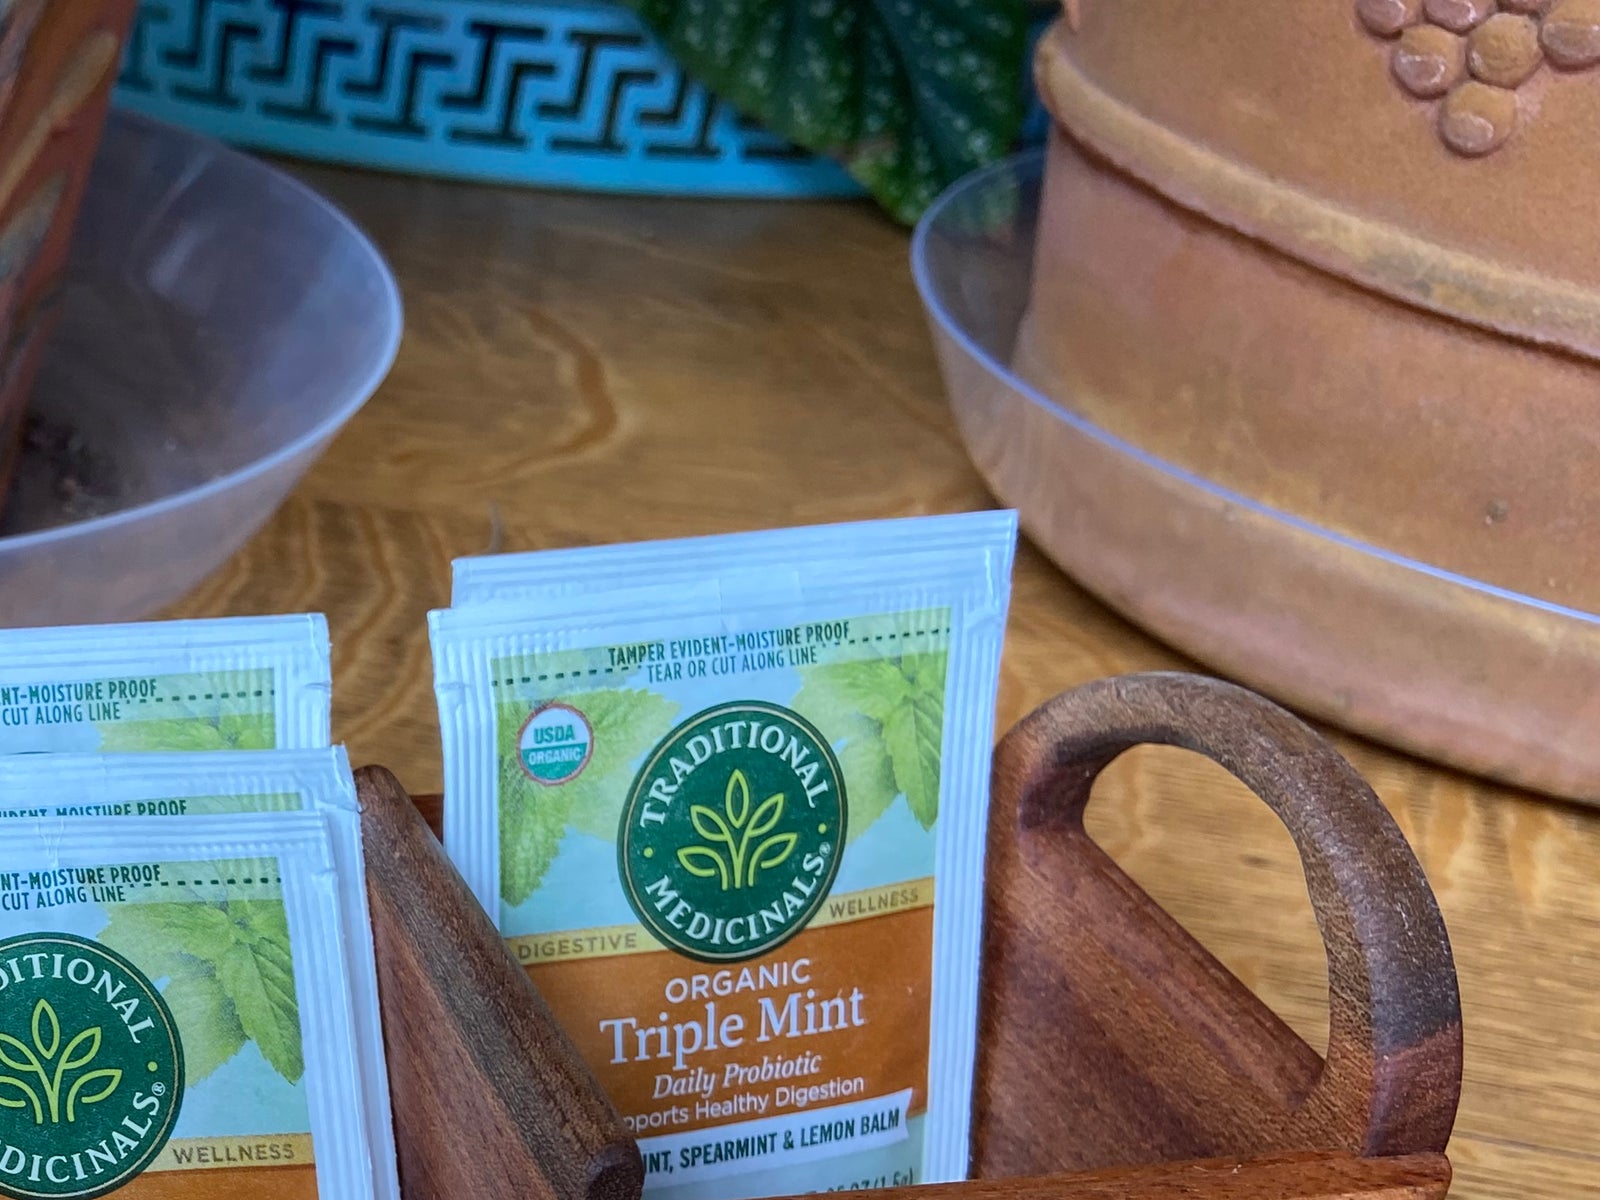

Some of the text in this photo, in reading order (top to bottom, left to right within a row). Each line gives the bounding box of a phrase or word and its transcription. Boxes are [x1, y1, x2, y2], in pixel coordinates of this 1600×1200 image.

[608, 621, 850, 666] TAMPER EVIDENT-MOISTURE PROOF
[647, 645, 817, 684] TEAR OR CUT ALONG LINE
[108, 678, 157, 699] PROOF
[2, 707, 29, 726] CUT
[35, 704, 83, 724] ALONG
[89, 701, 121, 721] LINE
[533, 725, 576, 744] USDA
[528, 746, 581, 766] ORGANIC
[639, 720, 829, 828] TRADITIONAL
[110, 864, 161, 884] PROOF
[2, 890, 32, 911] CUT
[36, 886, 87, 908] ALONG
[93, 885, 127, 903] LINE
[517, 887, 919, 960] DIGESTIVE WELLNESS
[665, 958, 811, 1004] ORGANIC
[600, 986, 865, 1071] Triple Mint
[652, 1050, 822, 1100] Daily Probiotic
[623, 1075, 864, 1133] pports Healthy Digestion
[172, 1143, 294, 1165] WELLNESS
[680, 1132, 778, 1169] SPEARMINT
[783, 1130, 795, 1150] &
[800, 1118, 855, 1148] LEMON
[860, 1107, 900, 1135] BALM
